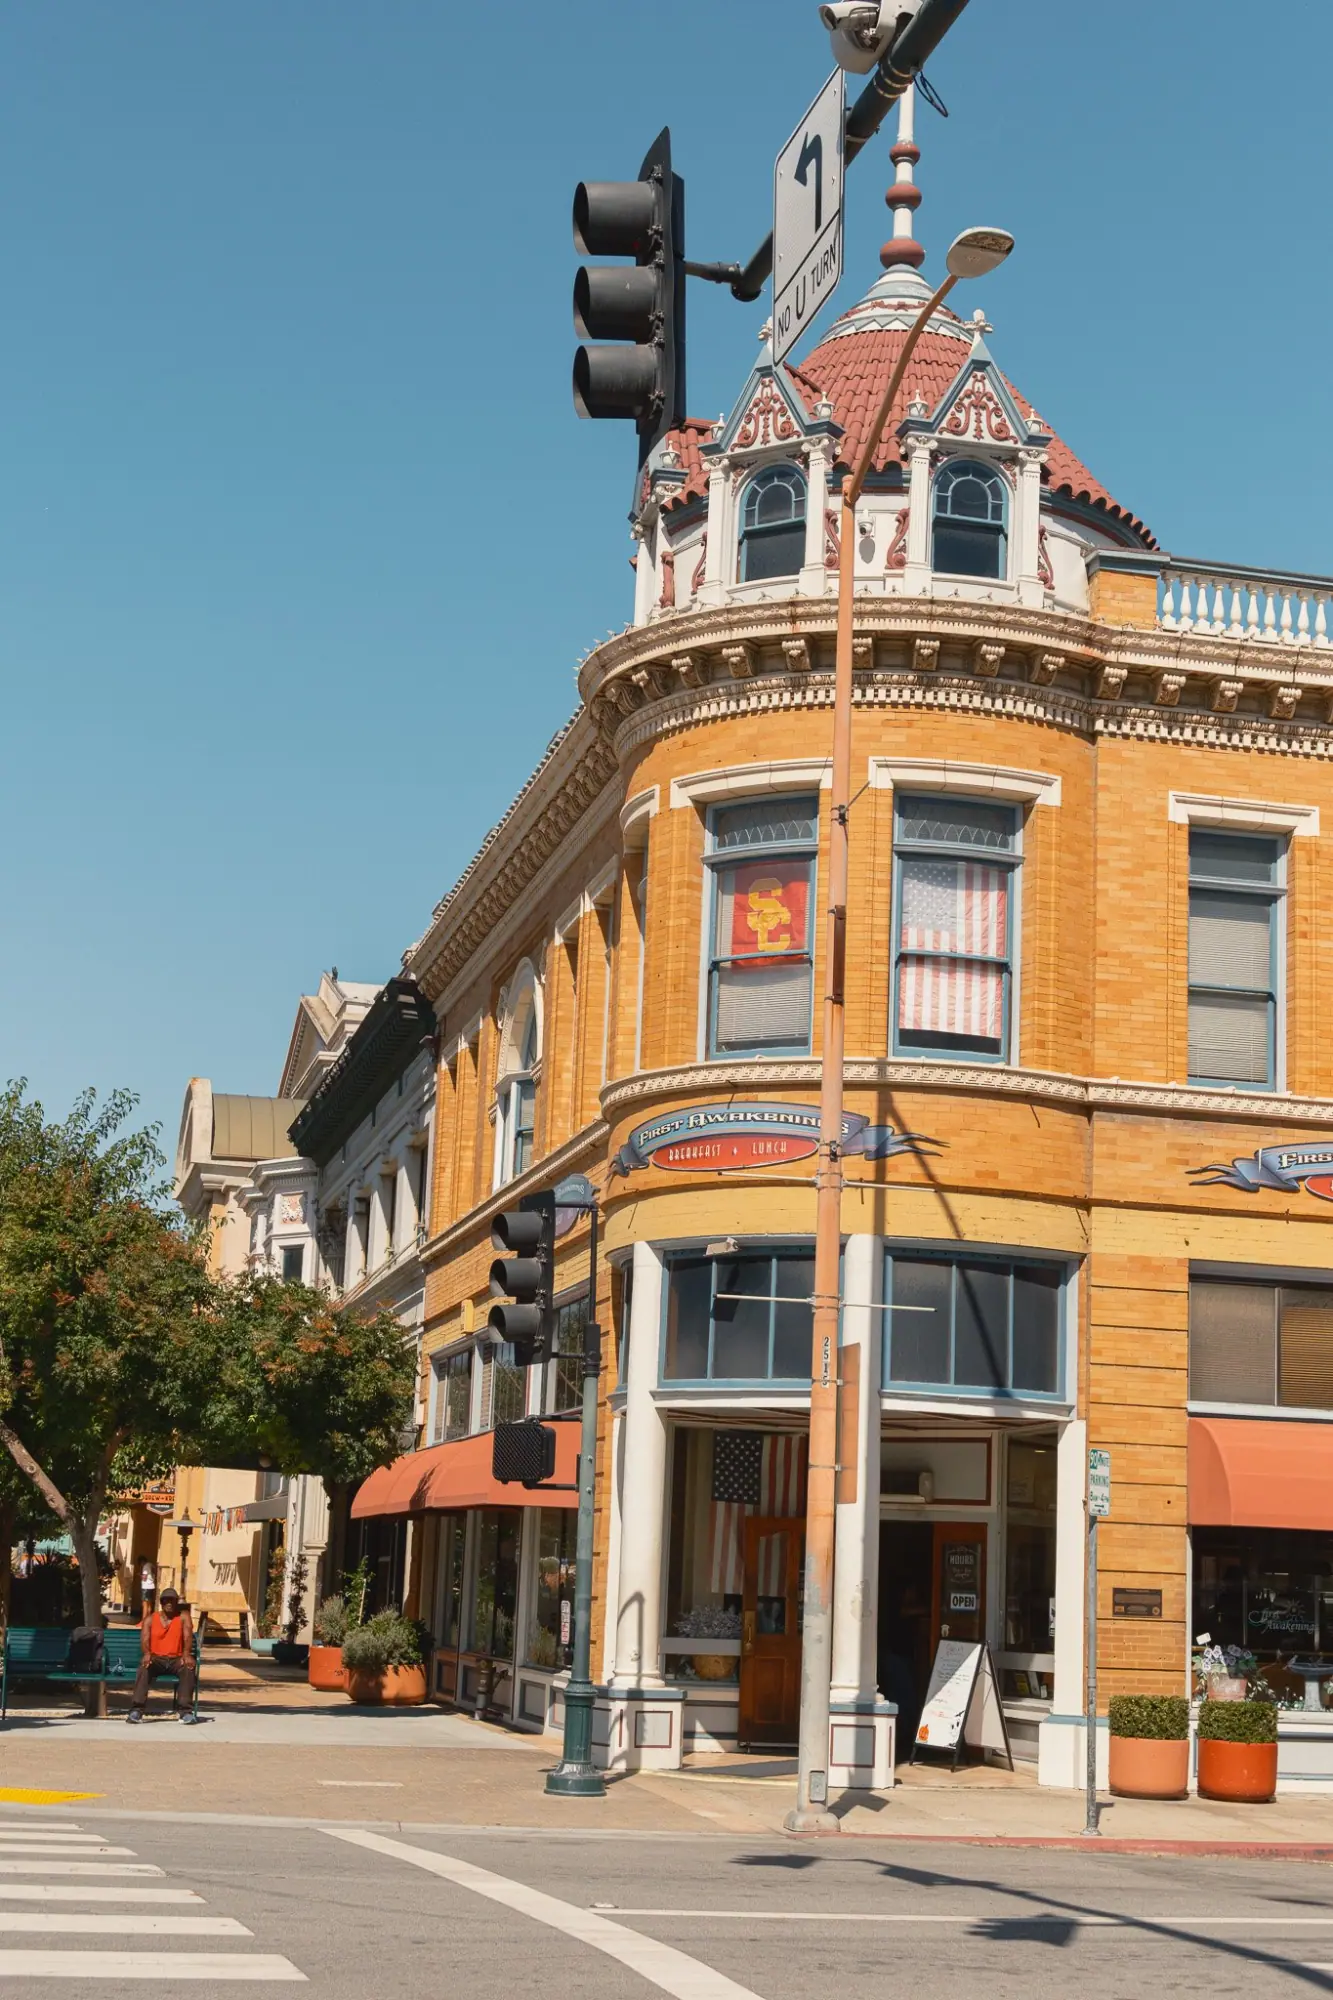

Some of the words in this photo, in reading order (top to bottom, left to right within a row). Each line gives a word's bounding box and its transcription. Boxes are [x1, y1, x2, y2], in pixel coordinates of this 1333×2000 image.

[778, 304, 791, 346] NO
[796, 274, 806, 320] U
[811, 236, 838, 294] TURN
[687, 1112, 849, 1135] AWAKENINS
[668, 1144, 721, 1161] BREAKFAST
[752, 1141, 787, 1155] LUNCH
[949, 1555, 974, 1565] HOURS
[952, 1595, 975, 1608] OPEN
